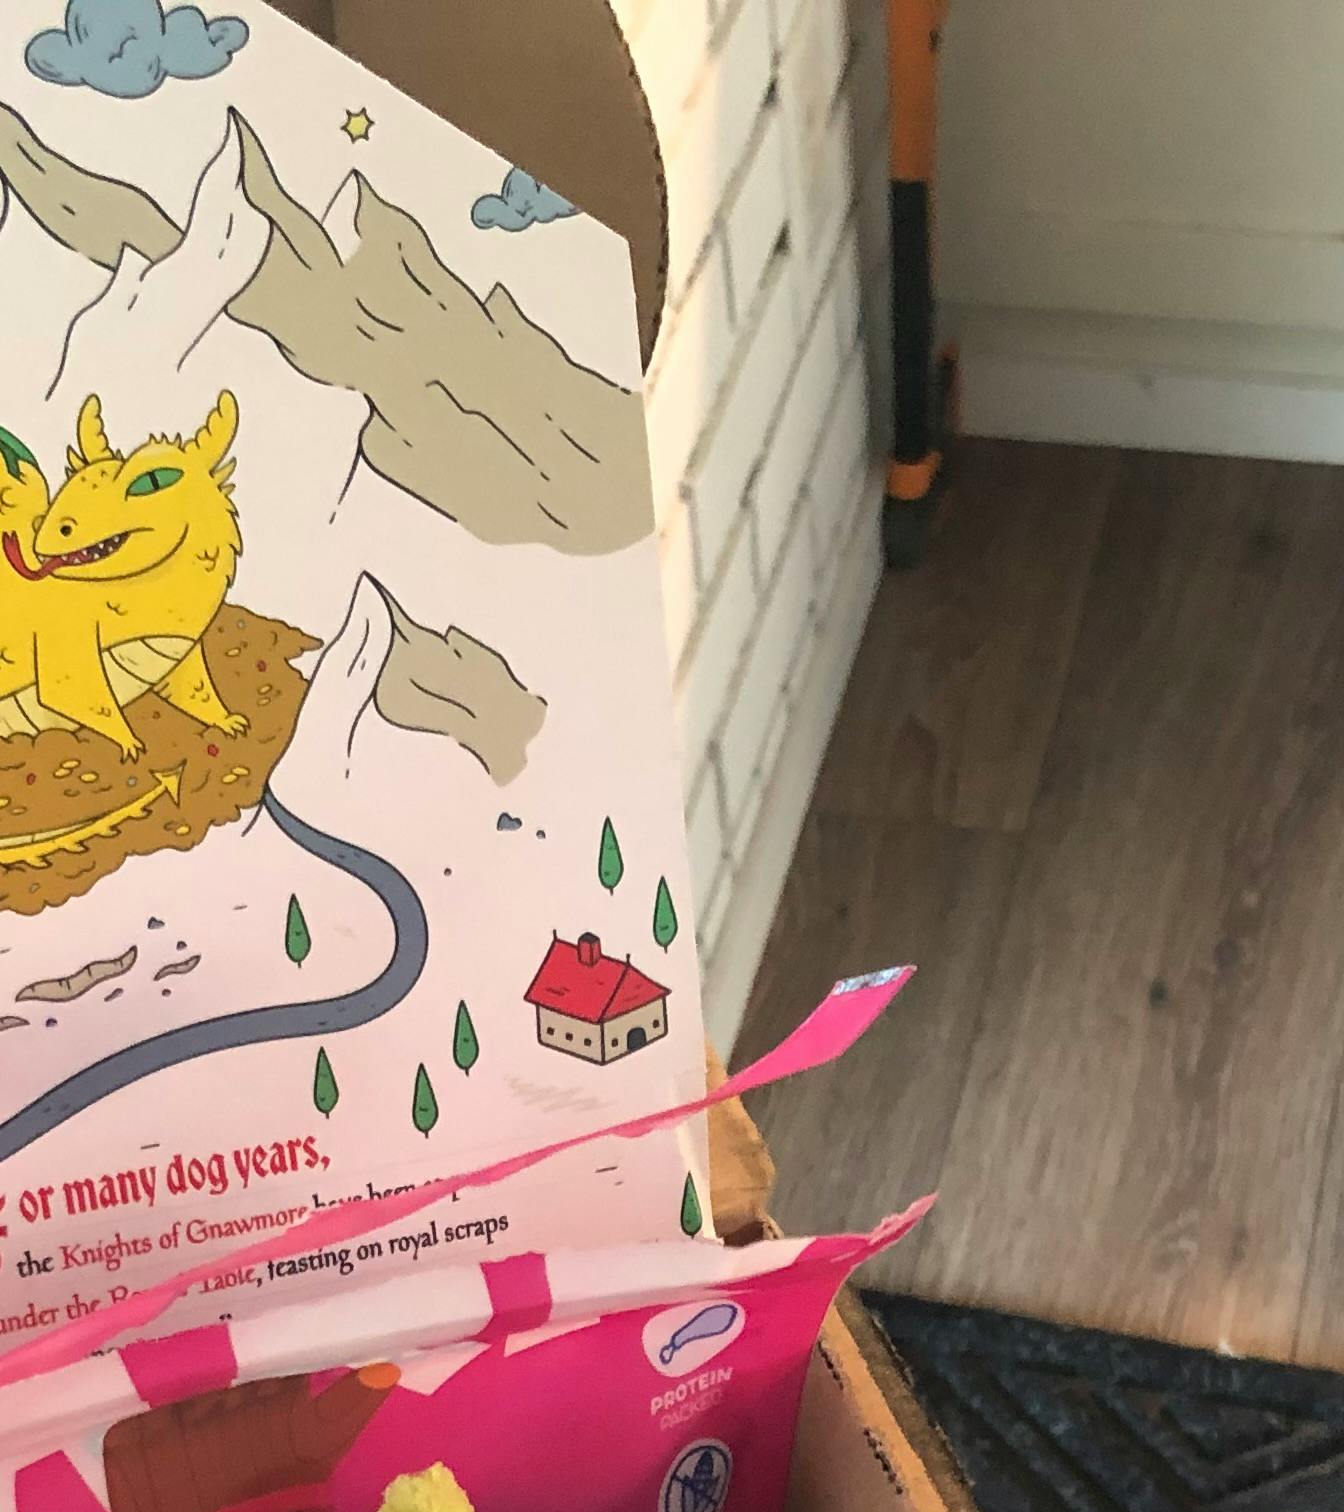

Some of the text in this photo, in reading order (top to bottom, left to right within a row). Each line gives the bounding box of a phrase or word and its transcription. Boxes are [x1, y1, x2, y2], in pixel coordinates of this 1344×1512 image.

[63, 1165, 157, 1216] many
[166, 1153, 225, 1196] dog
[233, 1135, 331, 1188] years,
[17, 1250, 55, 1278] the
[59, 1232, 153, 1272] Knights
[158, 1222, 181, 1250] of
[356, 1240, 383, 1261] on
[388, 1221, 439, 1261] royal
[444, 1214, 509, 1245] scraps
[650, 1367, 734, 1416] PROTEIN
